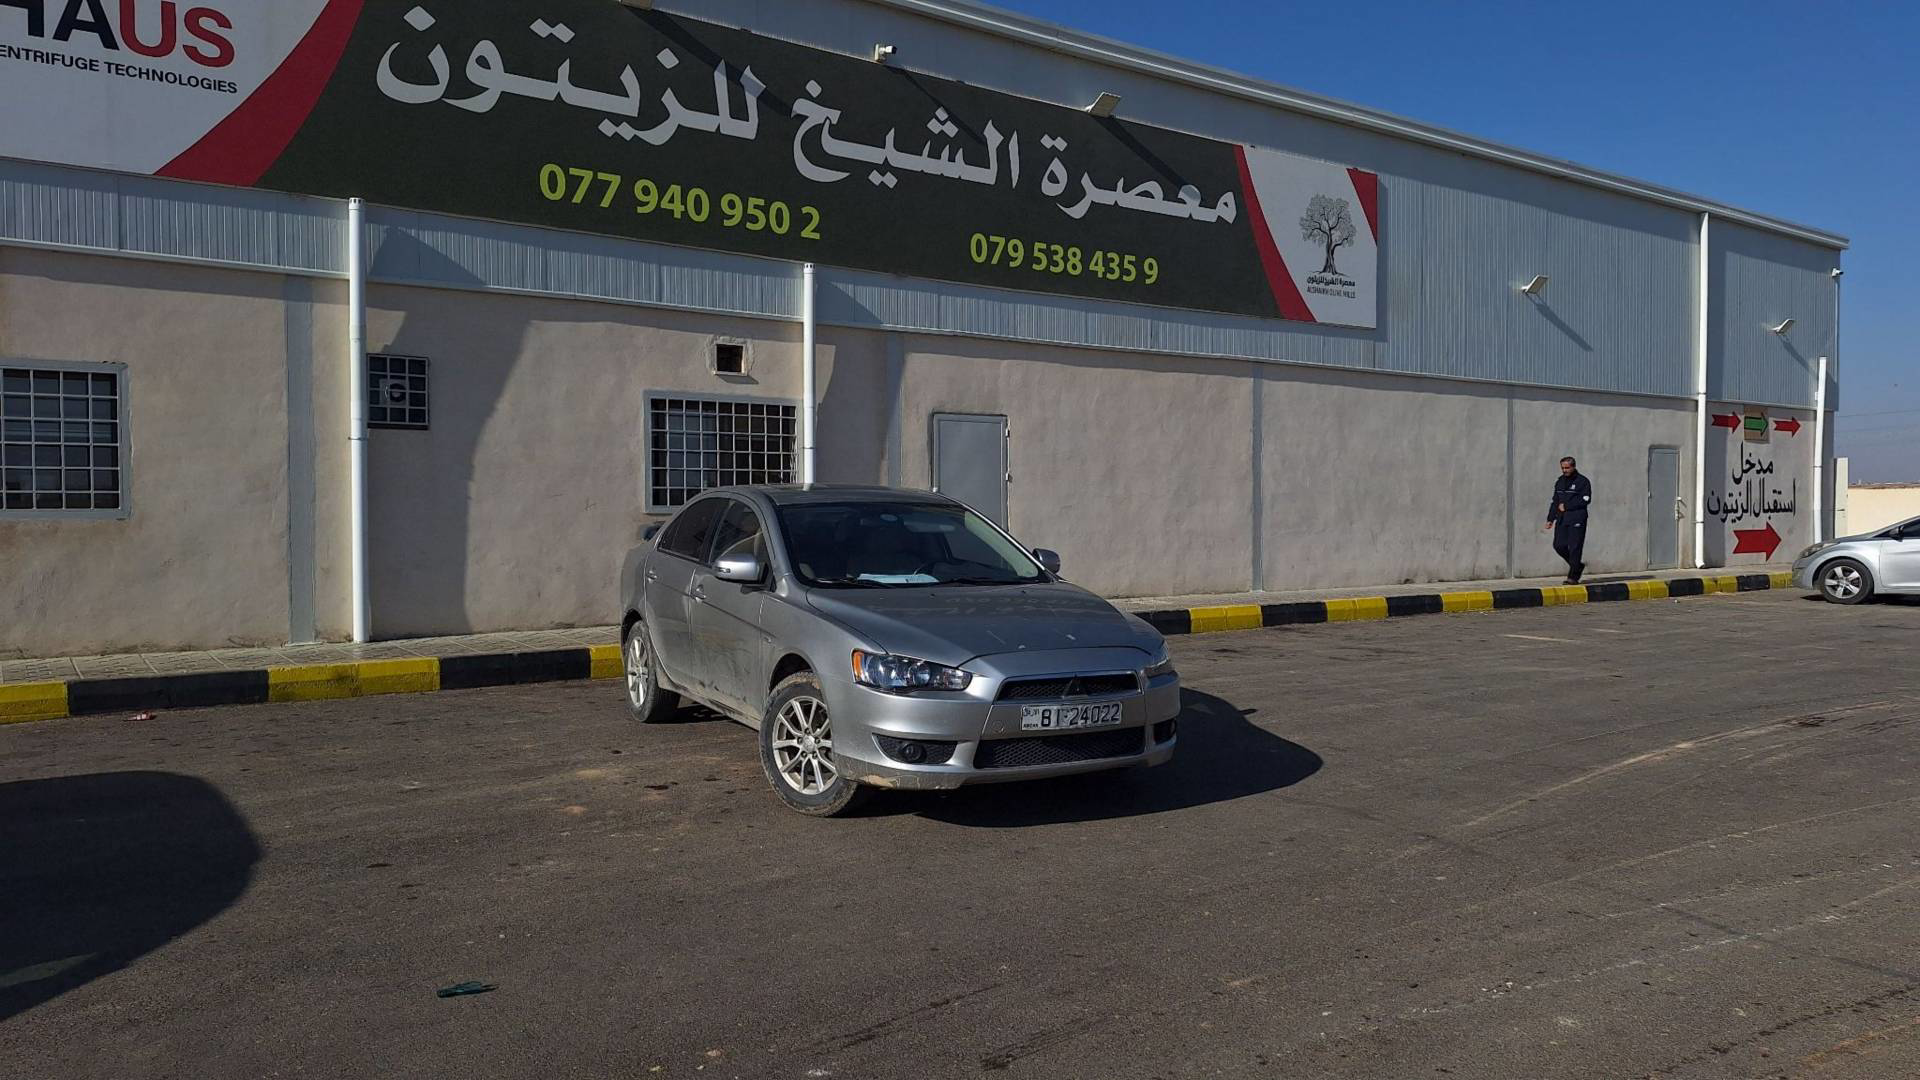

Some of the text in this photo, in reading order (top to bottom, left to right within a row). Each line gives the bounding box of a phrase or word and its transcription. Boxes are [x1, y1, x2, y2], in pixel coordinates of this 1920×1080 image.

[103, 61, 238, 94] TECHNOLOGIES
[376, 5, 1237, 223] معصرة الشيخ للزيتون
[539, 163, 822, 240] 077 940 950 2
[969, 233, 1159, 285] 079 538 435 9
[1732, 442, 1773, 485] مدخل
[1706, 478, 1796, 523] استقبال الزيتون
